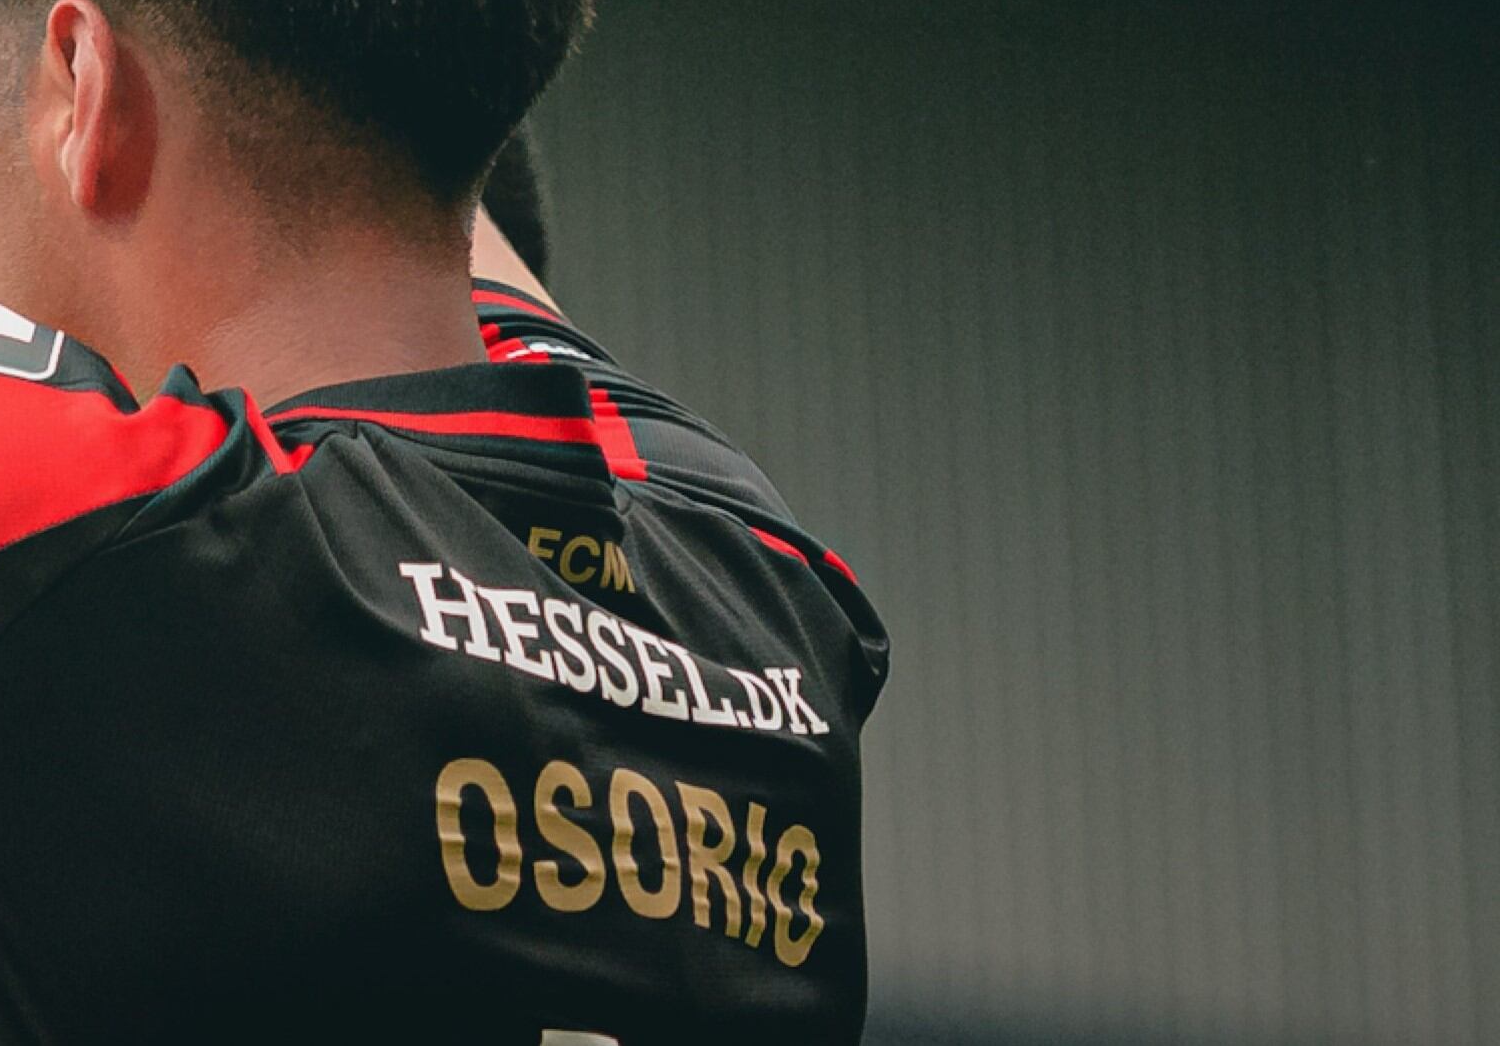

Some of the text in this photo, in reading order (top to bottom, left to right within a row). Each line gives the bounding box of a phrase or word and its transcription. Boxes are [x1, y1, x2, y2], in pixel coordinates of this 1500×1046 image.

[527, 526, 637, 594] FCM
[400, 562, 830, 735] HESSEL.DK
[435, 757, 825, 968] OSORIO
